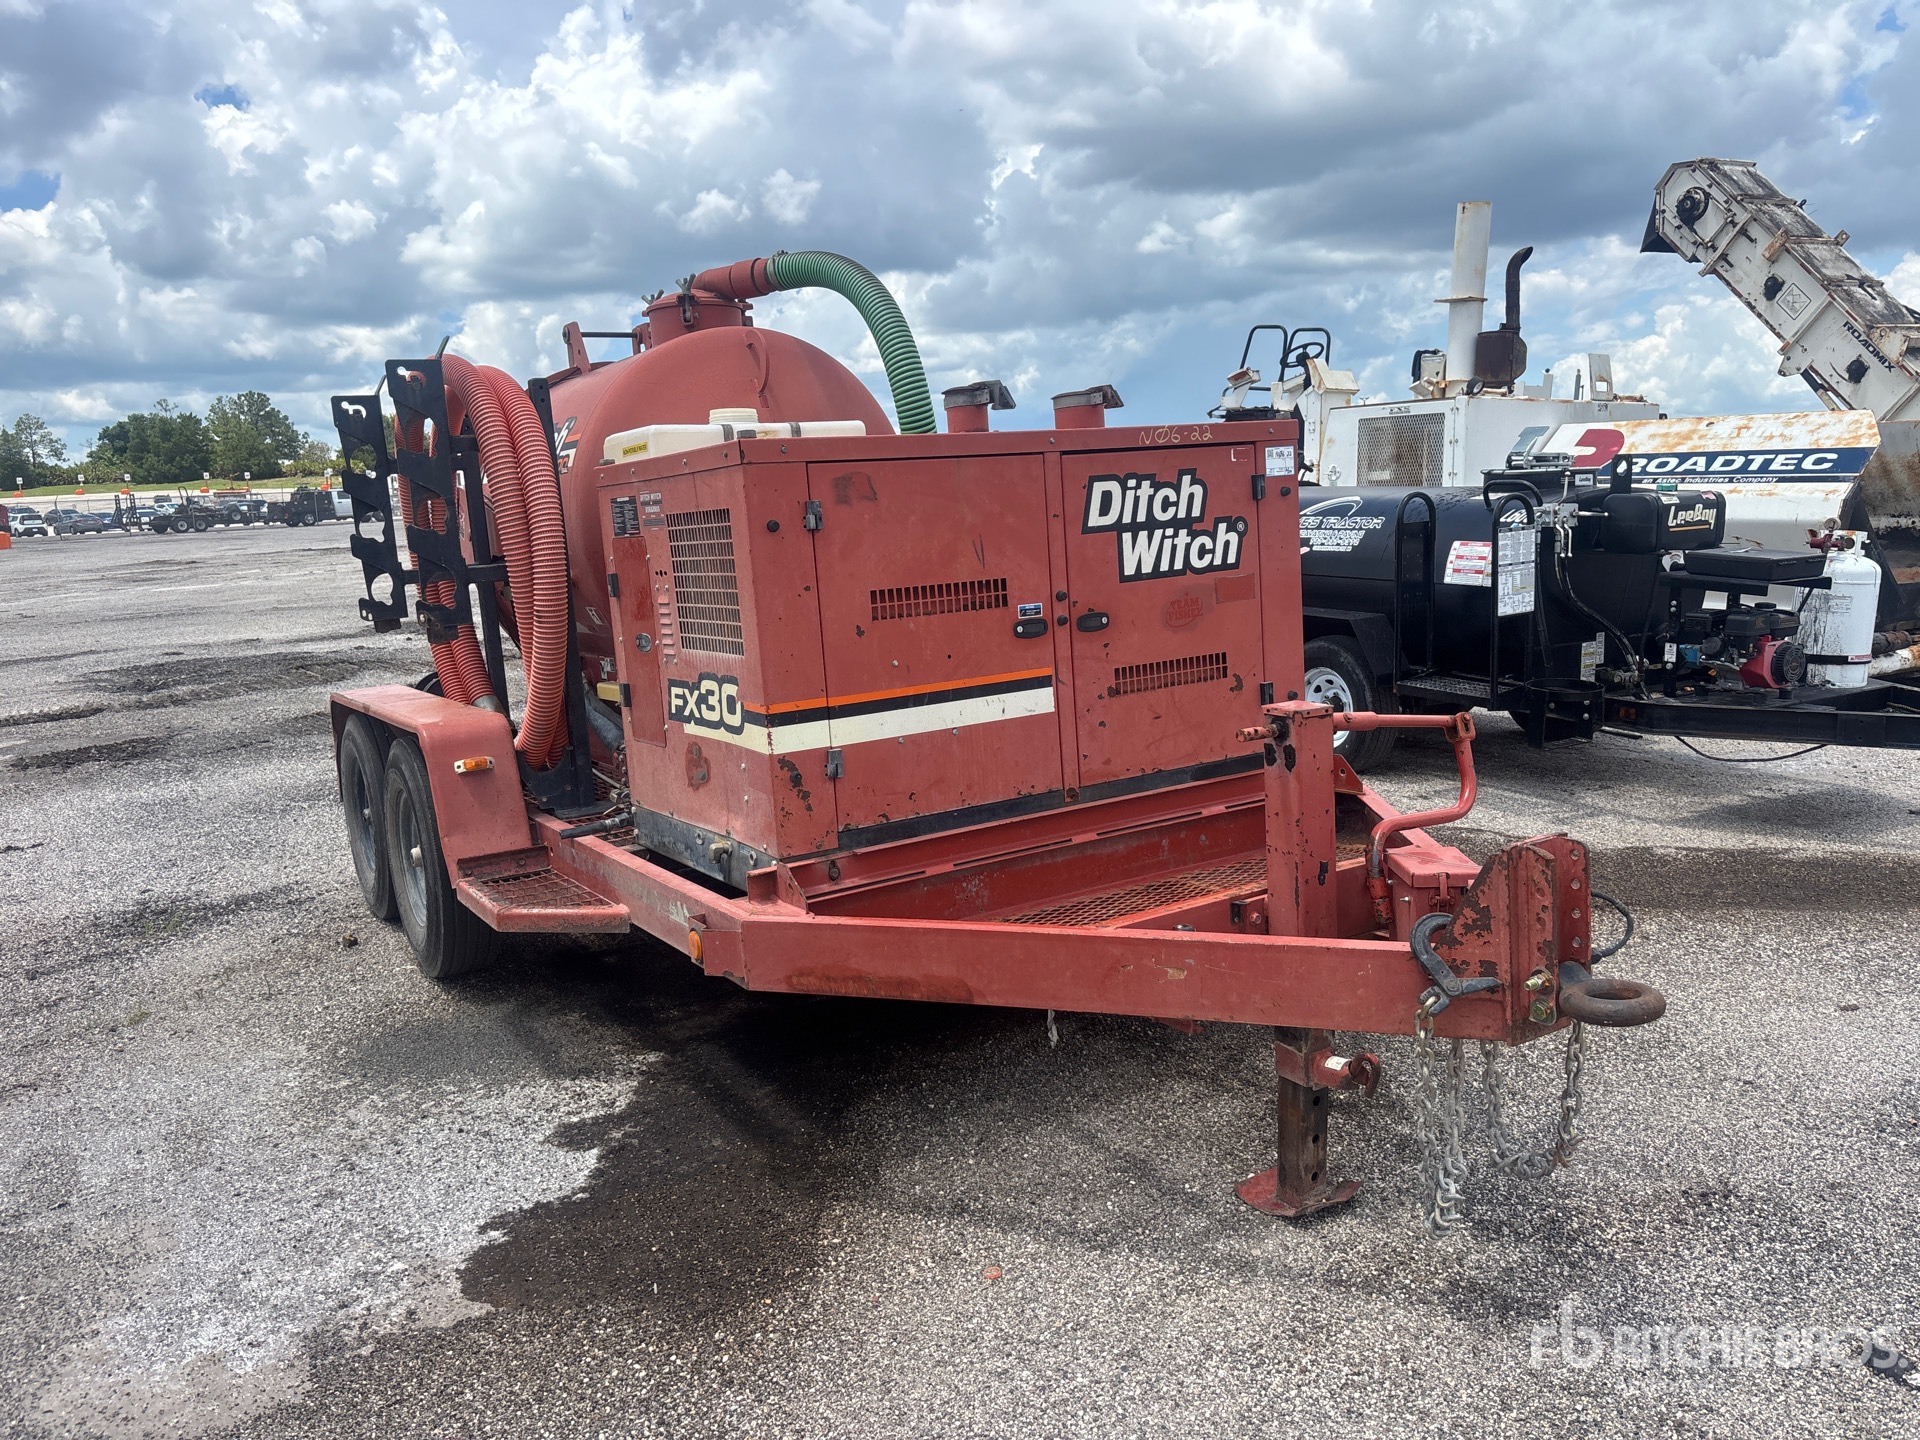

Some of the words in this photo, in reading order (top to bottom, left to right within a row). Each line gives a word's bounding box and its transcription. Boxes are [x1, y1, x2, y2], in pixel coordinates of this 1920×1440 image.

[1842, 320, 1896, 373] ROADMIX
[1684, 476, 1729, 484] Industries
[1733, 476, 1779, 484] Company
[1087, 474, 1204, 527] Ditch
[1667, 503, 1717, 530] LeeBoy
[1321, 516, 1386, 529] TRACTOR
[670, 679, 742, 727] FX30
